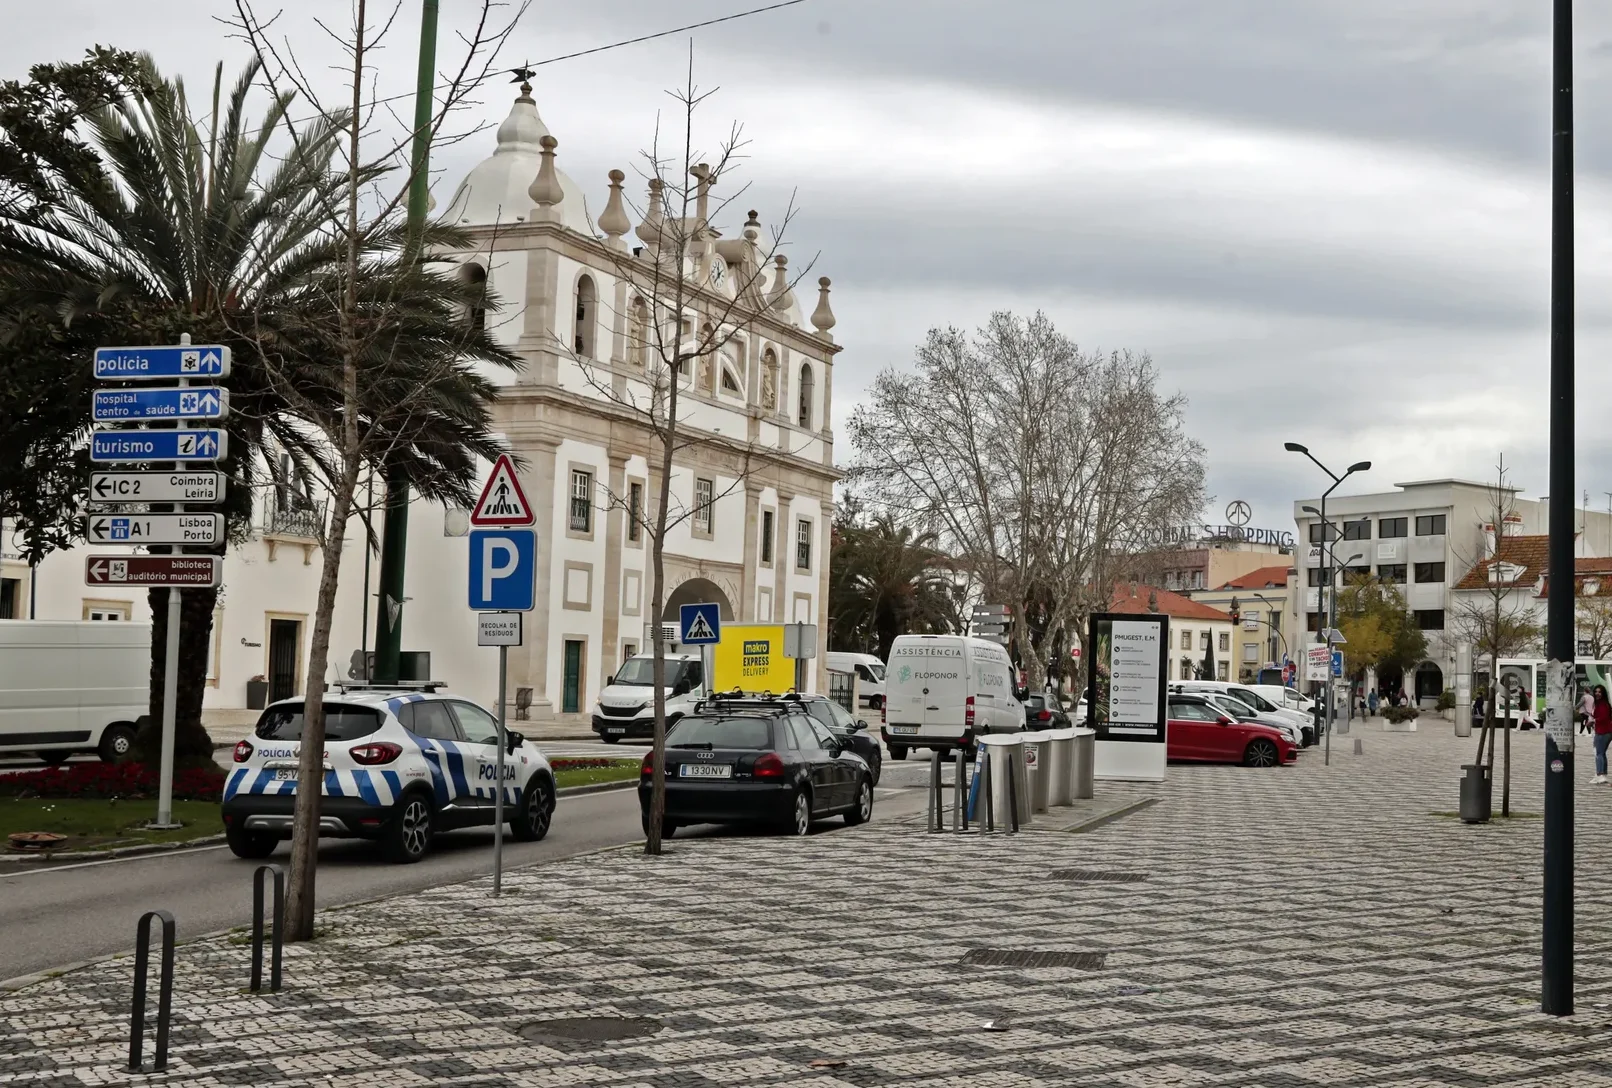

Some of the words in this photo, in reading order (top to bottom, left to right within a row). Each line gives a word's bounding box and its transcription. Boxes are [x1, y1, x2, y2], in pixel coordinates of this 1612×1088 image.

[97, 355, 149, 373] polícia
[96, 393, 138, 405] hospital
[96, 407, 129, 416] centro
[145, 404, 176, 415] saúde
[94, 438, 154, 453] turismo
[170, 476, 214, 486] Coimbra
[185, 489, 214, 498] Leiria
[179, 518, 212, 527] Lisboa
[184, 530, 212, 540] Porto
[1203, 524, 1295, 548] SHOPPING
[171, 561, 211, 569] biblioteca
[482, 537, 520, 602] P
[128, 572, 167, 581] auditório
[170, 572, 211, 583] municipal
[745, 643, 768, 653] makro
[896, 647, 961, 656] ASSISTÊNCIA
[742, 656, 769, 666] EXPRESS
[743, 667, 769, 676] DELIVERY
[914, 672, 958, 680] FLOPONOR
[257, 748, 292, 758] POLÍCIA
[479, 763, 515, 780] POLCIA
